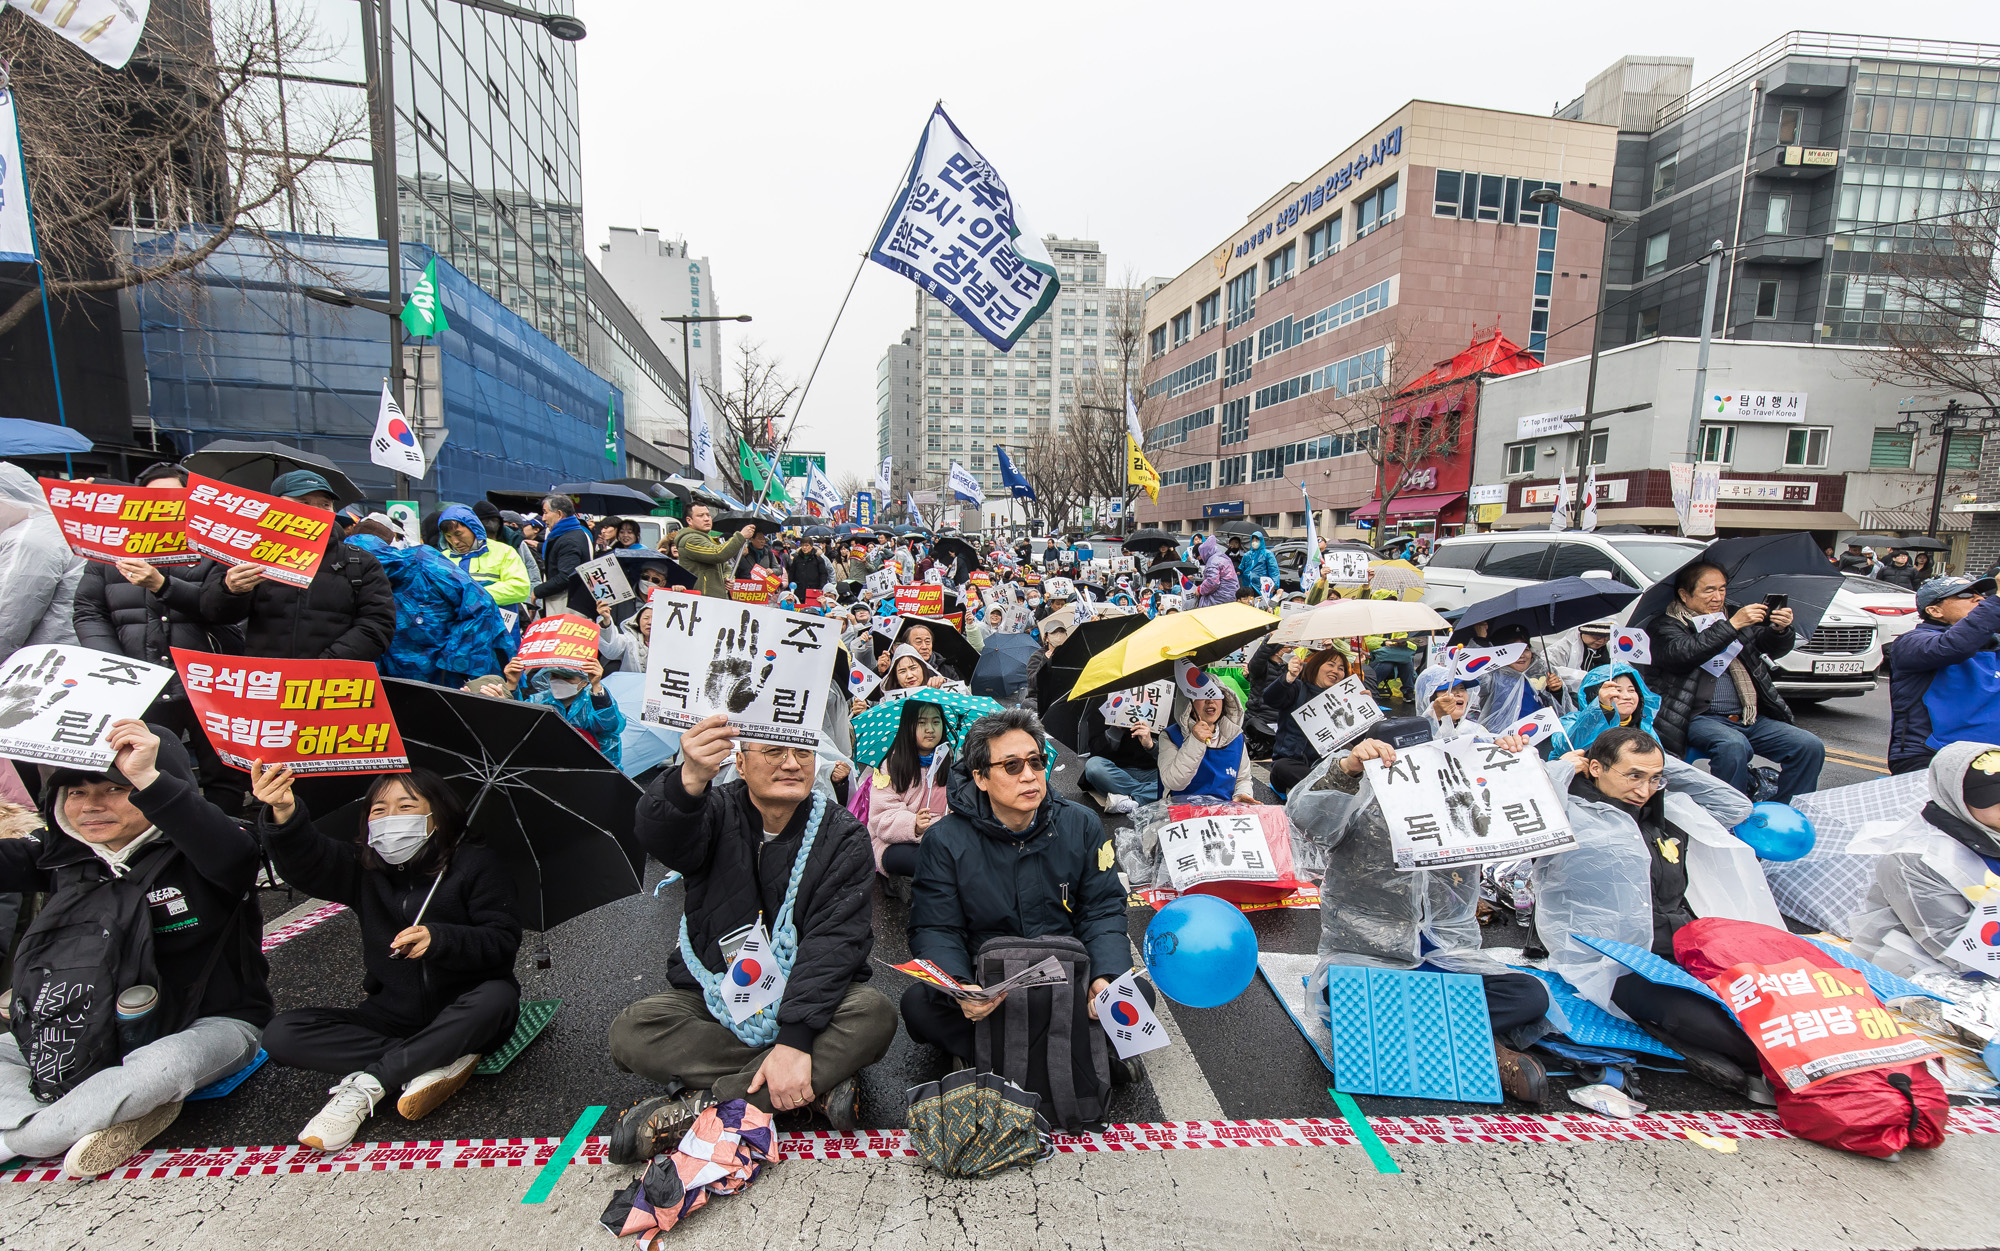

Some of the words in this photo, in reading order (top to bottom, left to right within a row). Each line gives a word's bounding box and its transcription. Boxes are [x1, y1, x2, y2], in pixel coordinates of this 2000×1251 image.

[1235, 222, 1273, 258] 서울경찰청
[1275, 125, 1403, 235] 산업기술안보수사대
[690, 275, 702, 349] 한국걸스우트
[1531, 418, 1541, 426] Top
[1541, 416, 1559, 424] Travel
[1559, 412, 1577, 421] Korea
[1738, 408, 1751, 416] Top
[1753, 408, 1774, 417] Travel
[1757, 487, 1778, 497] 카페
[49, 487, 124, 513] 윤석열
[119, 499, 187, 522] 파면!
[188, 484, 271, 521] 윤석열
[256, 507, 329, 542] 파면!
[63, 519, 128, 548] 국힘당
[188, 514, 262, 550] 국힘당
[249, 540, 321, 572] 해산!
[1355, 553, 1365, 562] 주
[731, 591, 768, 602] 파면하라!
[895, 588, 920, 598] 윤석열
[917, 590, 941, 601] 파면!
[918, 604, 941, 614] 해산!
[524, 618, 565, 640] 윤석열
[557, 621, 598, 642] 파면!
[666, 600, 702, 637] 자
[780, 617, 825, 653] 주
[518, 638, 561, 655] 국힘당
[554, 642, 596, 659] 해산!
[88, 657, 151, 687] 주
[1839, 662, 1860, 673] 8242
[187, 662, 282, 701] 윤석열
[280, 678, 376, 711] 파면!
[660, 667, 690, 709] 독
[772, 687, 810, 725] 립
[1299, 704, 1317, 722] 자
[1339, 679, 1357, 695] 주
[1125, 704, 1156, 727] 종식
[1315, 726, 1335, 743] 독
[1357, 702, 1376, 720] 립
[51, 709, 112, 747] 립
[205, 711, 297, 748] 국힘당
[296, 722, 391, 755] 해산!
[781, 728, 800, 736] 모이자!
[14, 740, 60, 753] 헌법재판소로
[61, 746, 88, 757] 모이자!
[1381, 754, 1421, 785] 자
[1476, 746, 1521, 771] 주
[1166, 822, 1189, 842] 자
[1230, 817, 1254, 834] 주
[1404, 813, 1443, 847] 독
[1502, 798, 1547, 837] 립
[1176, 854, 1199, 873] 독
[1241, 850, 1264, 869] 립
[1729, 968, 1816, 1013] 윤석열
[1760, 1005, 1857, 1050] 국힘당
[1215, 1125, 1284, 1141] DANGER!
[1411, 1123, 1446, 1138] 위험
[1479, 1121, 1549, 1135] DANGER!
[1562, 1119, 1629, 1135] 안전제일
[1631, 1118, 1670, 1134] 危險
[823, 1137, 861, 1152] 危險
[868, 1137, 900, 1151] 위험
[1102, 1129, 1136, 1145] 危險
[1144, 1128, 1178, 1144] 위험
[161, 1152, 239, 1170] 안전제일
[244, 1151, 282, 1167] 危險
[287, 1150, 322, 1166] 위험
[363, 1147, 443, 1163] DANGER!
[456, 1145, 529, 1161] 안전제일
